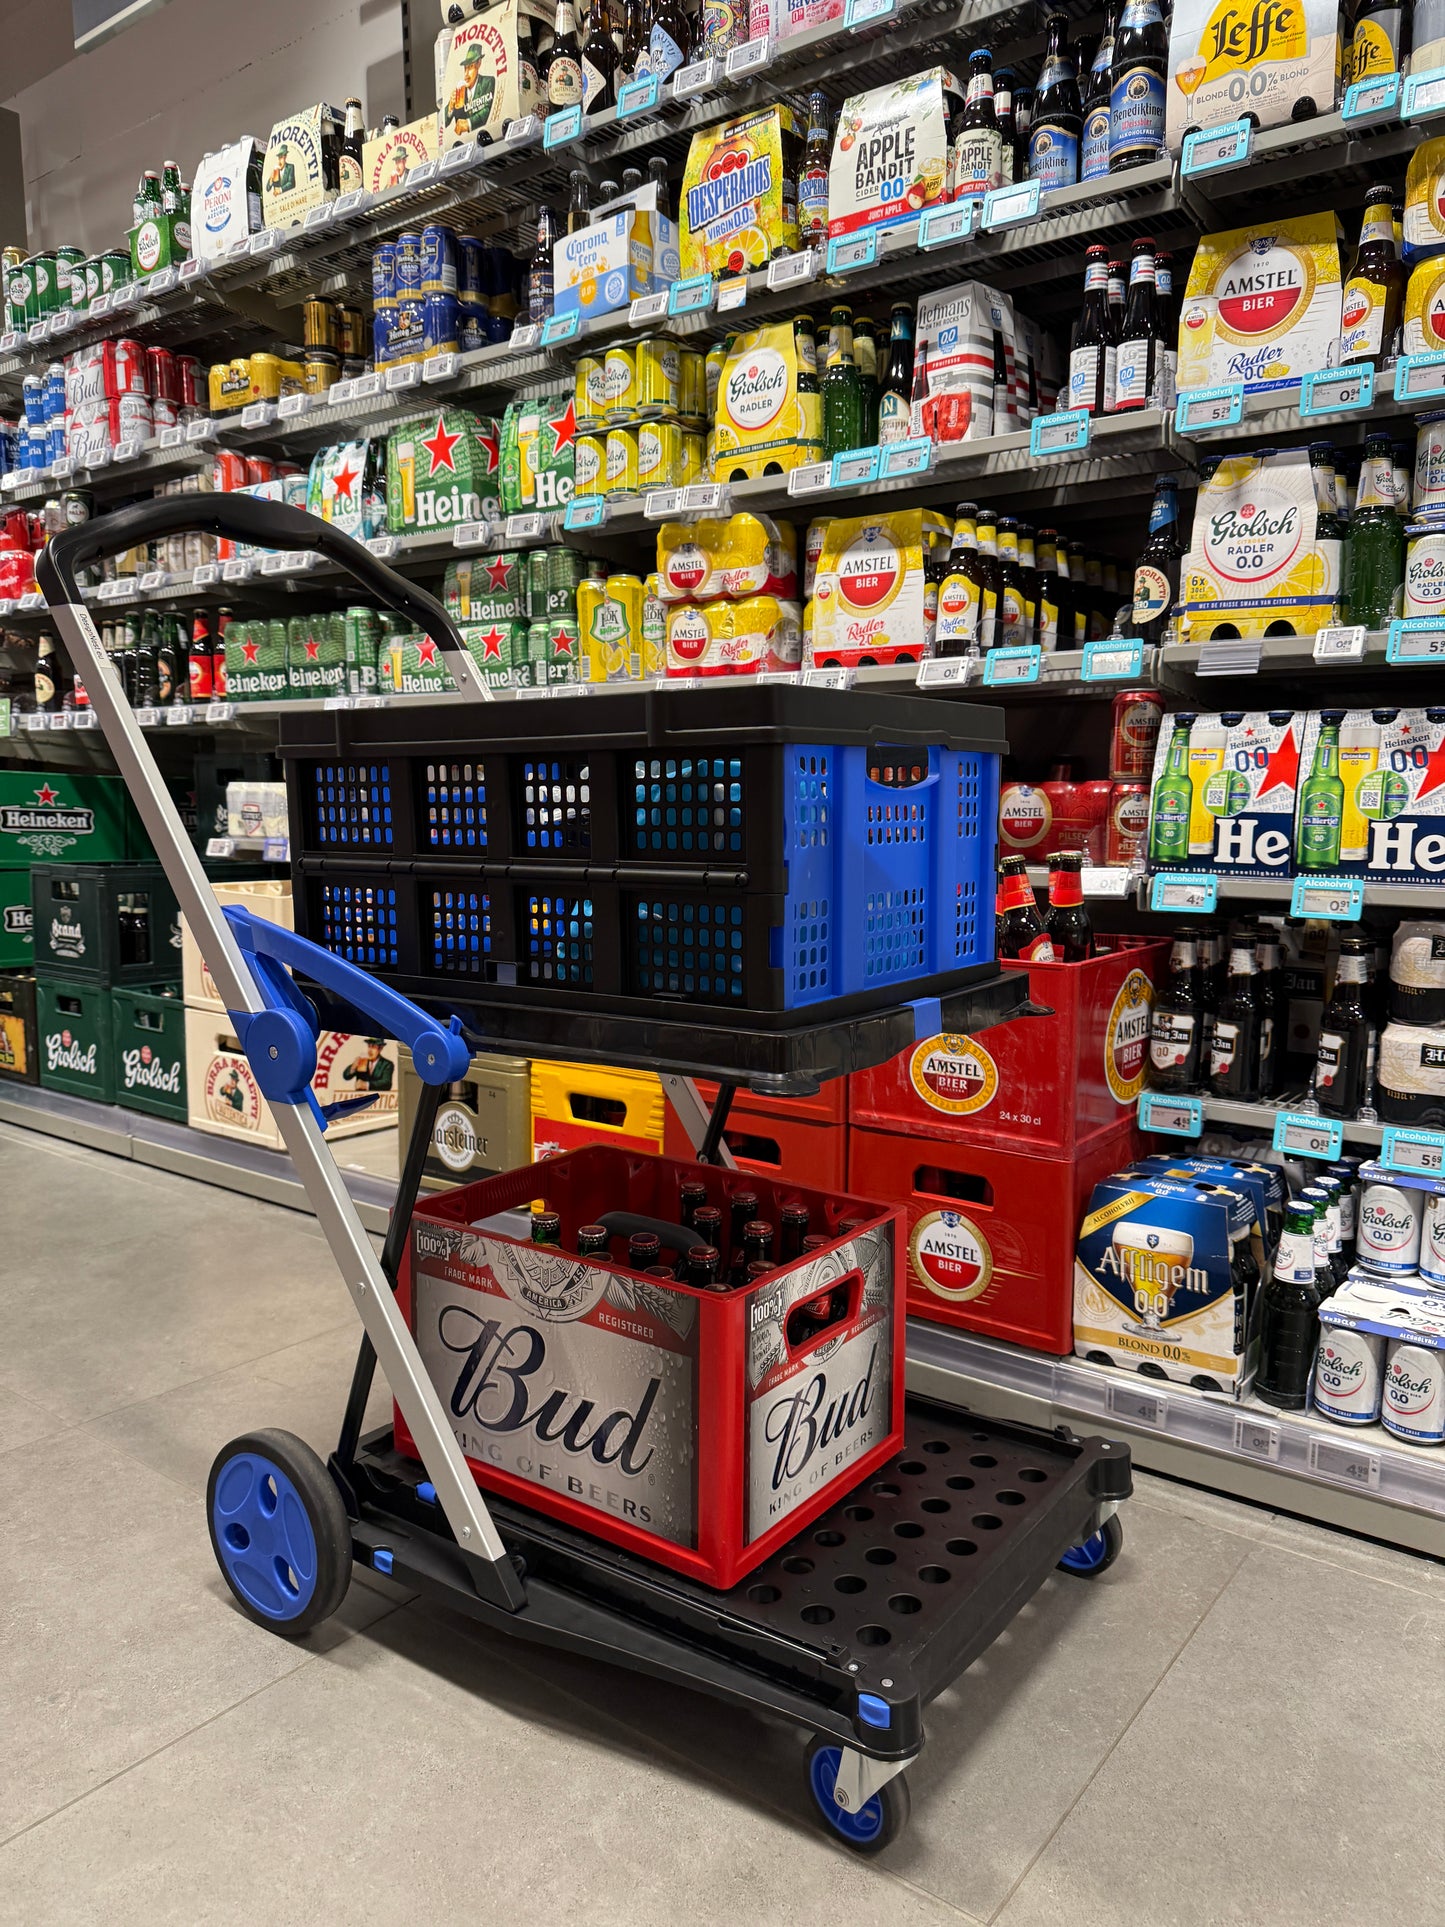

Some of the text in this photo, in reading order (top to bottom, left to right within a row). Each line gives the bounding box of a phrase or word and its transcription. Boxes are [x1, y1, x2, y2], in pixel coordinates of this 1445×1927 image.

[1209, 0, 1294, 64] Leffe
[454, 24, 508, 78] MORETTI
[1196, 90, 1229, 105] BLONDE
[1280, 68, 1309, 82] BLOND
[1112, 105, 1163, 126] Benediktiner
[1121, 119, 1152, 131] Weissbier
[1194, 124, 1240, 142] Alcoholvrij
[1118, 130, 1155, 140] ALKOHOLFREI
[270, 126, 319, 181] MORETTI
[856, 126, 916, 172] APPLE
[961, 147, 992, 162] APPLE
[1217, 143, 1237, 158] 6.49
[855, 157, 915, 190] BANDIT
[961, 161, 992, 171] BANDIT
[204, 191, 232, 211] PERONI
[689, 159, 770, 229] DESPERADOS
[856, 188, 879, 198] CIDER
[867, 202, 902, 221] JUICY APPLE
[618, 218, 623, 226] 6
[707, 221, 733, 240] VIRGIN
[566, 230, 608, 262] Corona
[578, 251, 598, 268] Cero
[1223, 270, 1297, 296] AMSTEL
[1242, 296, 1275, 312] BIER
[1227, 346, 1285, 376] Radler
[1312, 365, 1363, 381] Alcoholvrij
[69, 374, 99, 400] Bud
[730, 362, 786, 403] Grolsch
[1188, 386, 1234, 401] Alcoholvrij
[1339, 387, 1361, 402] 0.94
[739, 398, 773, 414] RADLER
[1212, 406, 1231, 420] 5.29
[1040, 411, 1080, 425] Alcoholvrij
[1210, 506, 1298, 546] Grolsch
[1227, 544, 1274, 555] RADLER
[671, 560, 704, 572] AMSTEL
[843, 558, 894, 574] AMSTEL
[1236, 556, 1263, 570] 0.0
[681, 571, 697, 579] BIER
[855, 576, 879, 589] BIER
[943, 593, 968, 602] AMSTEL
[1422, 587, 1442, 596] 0.0
[673, 628, 706, 639] AMSTEL
[846, 619, 887, 640] Radler
[682, 640, 698, 649] BIER
[1093, 642, 1134, 650] Alcoholvrij
[1230, 736, 1271, 750] Heineken
[1384, 734, 1431, 749] Heineken
[1235, 746, 1269, 773] 0.0
[1391, 744, 1429, 773] 0.0
[7, 811, 89, 828] Heineken
[1004, 806, 1043, 817] AMSTEL
[1014, 820, 1033, 828] BIER
[1214, 818, 1290, 864] He
[1164, 875, 1208, 884] Alcoholvrij
[1304, 879, 1353, 890] Alcoholvrij
[52, 919, 81, 938] Brand
[1117, 1010, 1150, 1046] AMSTEL
[46, 1033, 96, 1075] Grolsch
[1122, 1044, 1143, 1062] BIER
[122, 1050, 180, 1094] Grolsch
[926, 1058, 981, 1078] AMSTEL
[206, 1060, 229, 1096] BIRRA
[938, 1076, 968, 1090] BIER
[999, 1110, 1011, 1121] 24
[1020, 1112, 1032, 1124] 30
[1285, 1114, 1333, 1129] Alcoholvrij
[1394, 1131, 1445, 1146] Alcoholvrij
[1421, 1154, 1442, 1168] 5.69
[1093, 1198, 1135, 1224] ALCOHOLVRIJ
[1362, 1207, 1413, 1229] Grolsch
[420, 1234, 446, 1254] 100%
[1373, 1231, 1392, 1241] 0.0
[924, 1239, 975, 1263] AMSTEL
[937, 1259, 962, 1274] BIER
[1096, 1247, 1211, 1296] Affligem
[444, 1266, 493, 1289] TRADE MARK
[526, 1291, 564, 1308] AMERICA
[754, 1300, 779, 1323] 100%
[598, 1312, 654, 1339] REGISTERED
[1118, 1336, 1161, 1355] BLOND
[784, 1364, 799, 1376] MARK
[1323, 1373, 1341, 1386] 0.0
[437, 1304, 663, 1475] Bud
[1390, 1390, 1408, 1404] 0.0
[764, 1342, 878, 1491] Bud
[768, 1427, 874, 1516] KING OF BEERS
[517, 1456, 653, 1525] OF BEERS
